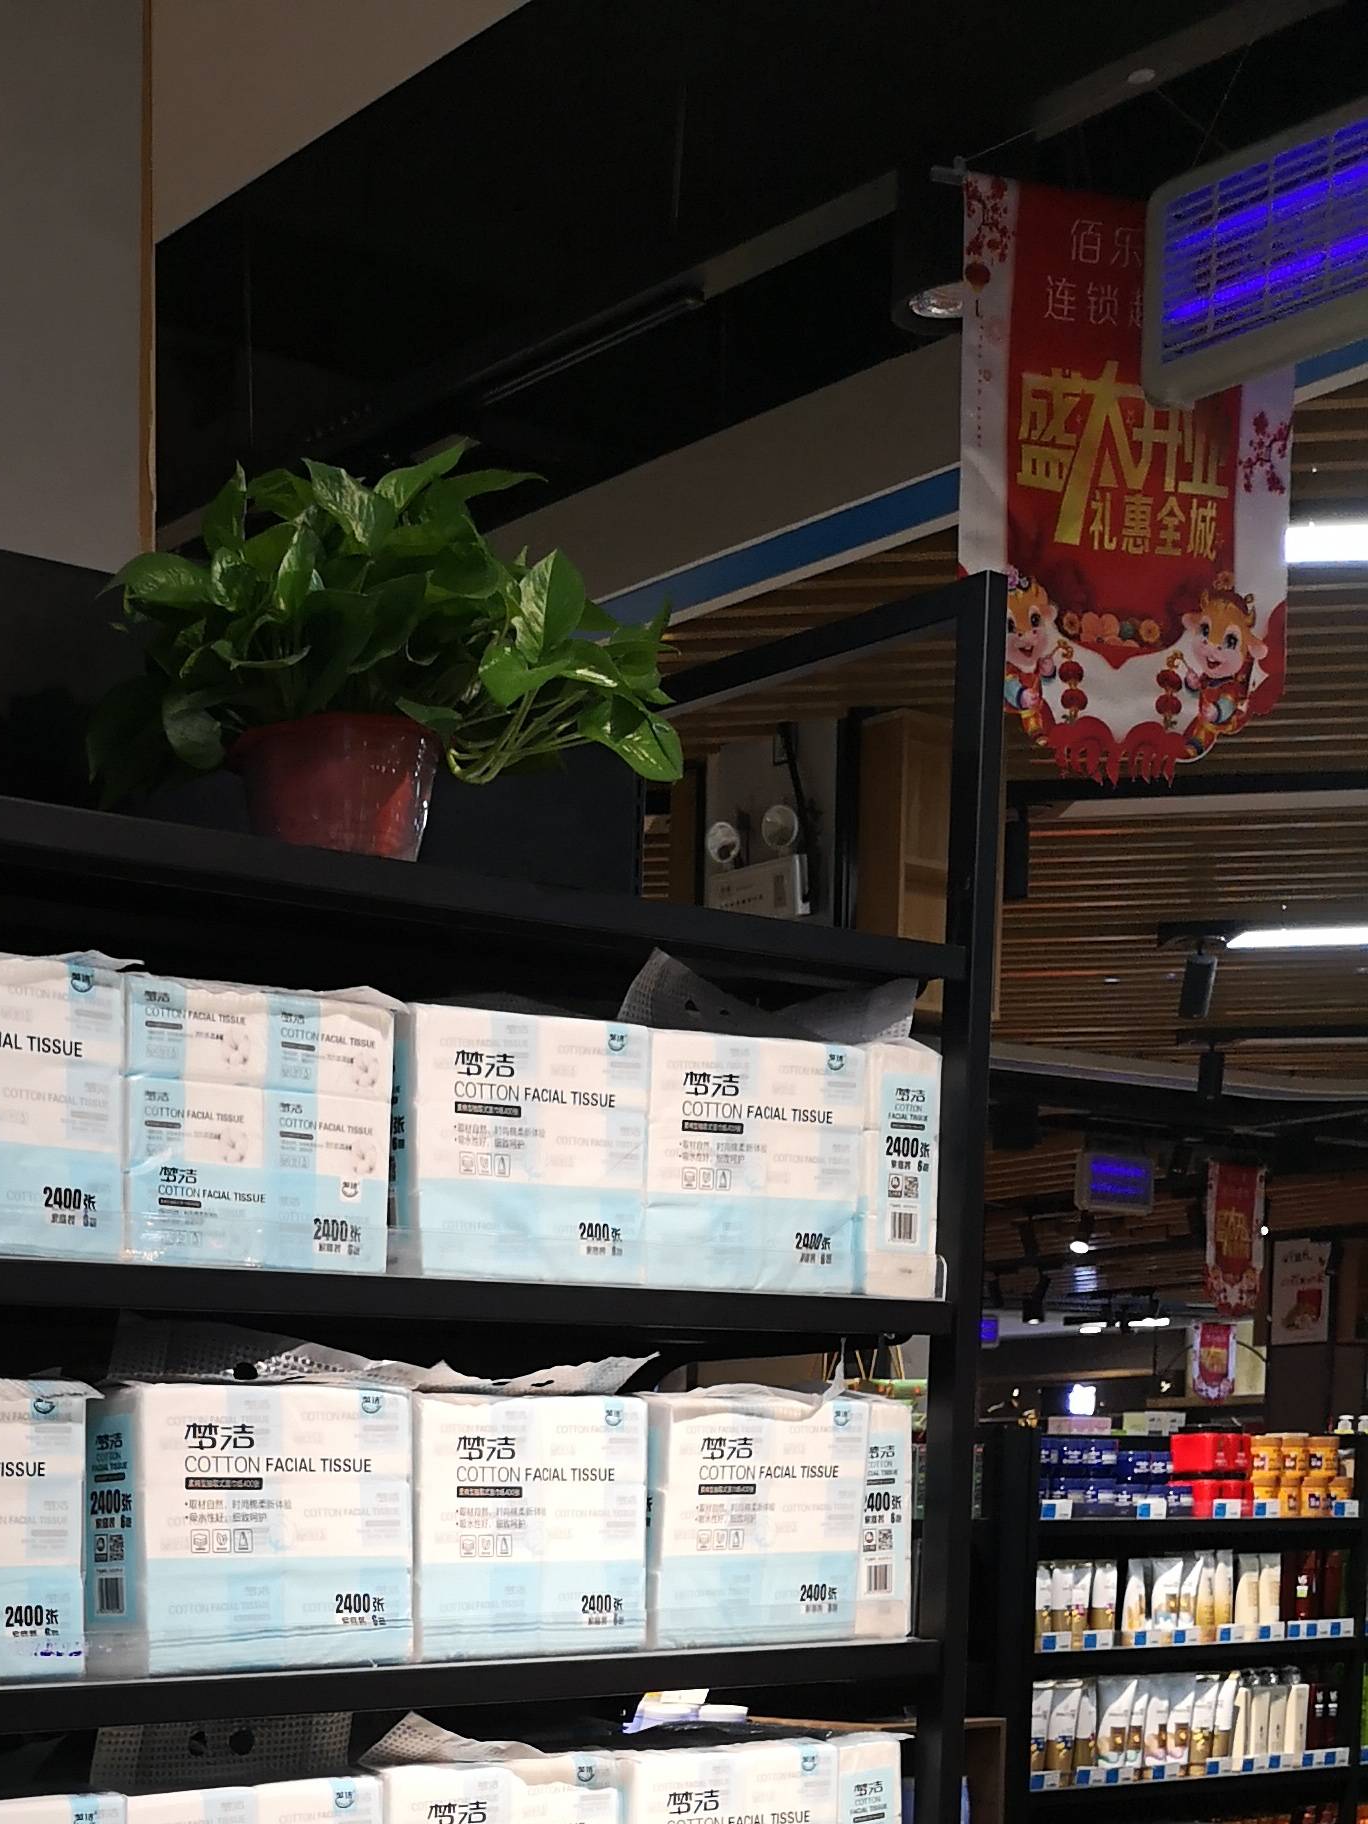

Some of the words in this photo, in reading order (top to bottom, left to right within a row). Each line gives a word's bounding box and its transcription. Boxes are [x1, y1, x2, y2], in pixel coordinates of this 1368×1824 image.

[1090, 490, 1217, 561] 礼惠全城
[27, 1035, 83, 1057] TISSUE
[455, 1050, 515, 1078] 梦洁
[454, 1081, 519, 1102] COTTON
[524, 1087, 566, 1104] FACIAL
[571, 1091, 616, 1108] TISSUE
[683, 1072, 739, 1097] 梦洁
[682, 1100, 742, 1120] COTTON
[747, 1105, 787, 1121] FACIAL
[792, 1109, 832, 1124] TISSUE
[886, 1136, 929, 1158] 2400张
[159, 1166, 197, 1184] 梦洁
[43, 1187, 96, 1211] 2400张
[158, 1185, 201, 1198] COTTON
[202, 1188, 231, 1201] FACIAL
[234, 1192, 266, 1204] TISSUE
[185, 1423, 255, 1450] 梦洁
[457, 1436, 516, 1461] 梦洁
[701, 1437, 753, 1460] 梦洁
[184, 1456, 260, 1473] COTTON
[266, 1458, 316, 1473] FACIAL
[320, 1458, 371, 1473] TISSUE
[457, 1466, 520, 1482] COTTON
[525, 1467, 567, 1481] FACIAL
[571, 1467, 615, 1481] TISSUE
[699, 1465, 756, 1481] COTTON
[759, 1466, 796, 1479] FACIAL
[801, 1465, 839, 1478] TISSUE
[336, 1593, 384, 1614] 2400张
[800, 1584, 837, 1602] 2400张
[5, 1605, 59, 1628] 2400张
[667, 1789, 719, 1814] 梦洁
[771, 1810, 810, 1824] TISSUE
